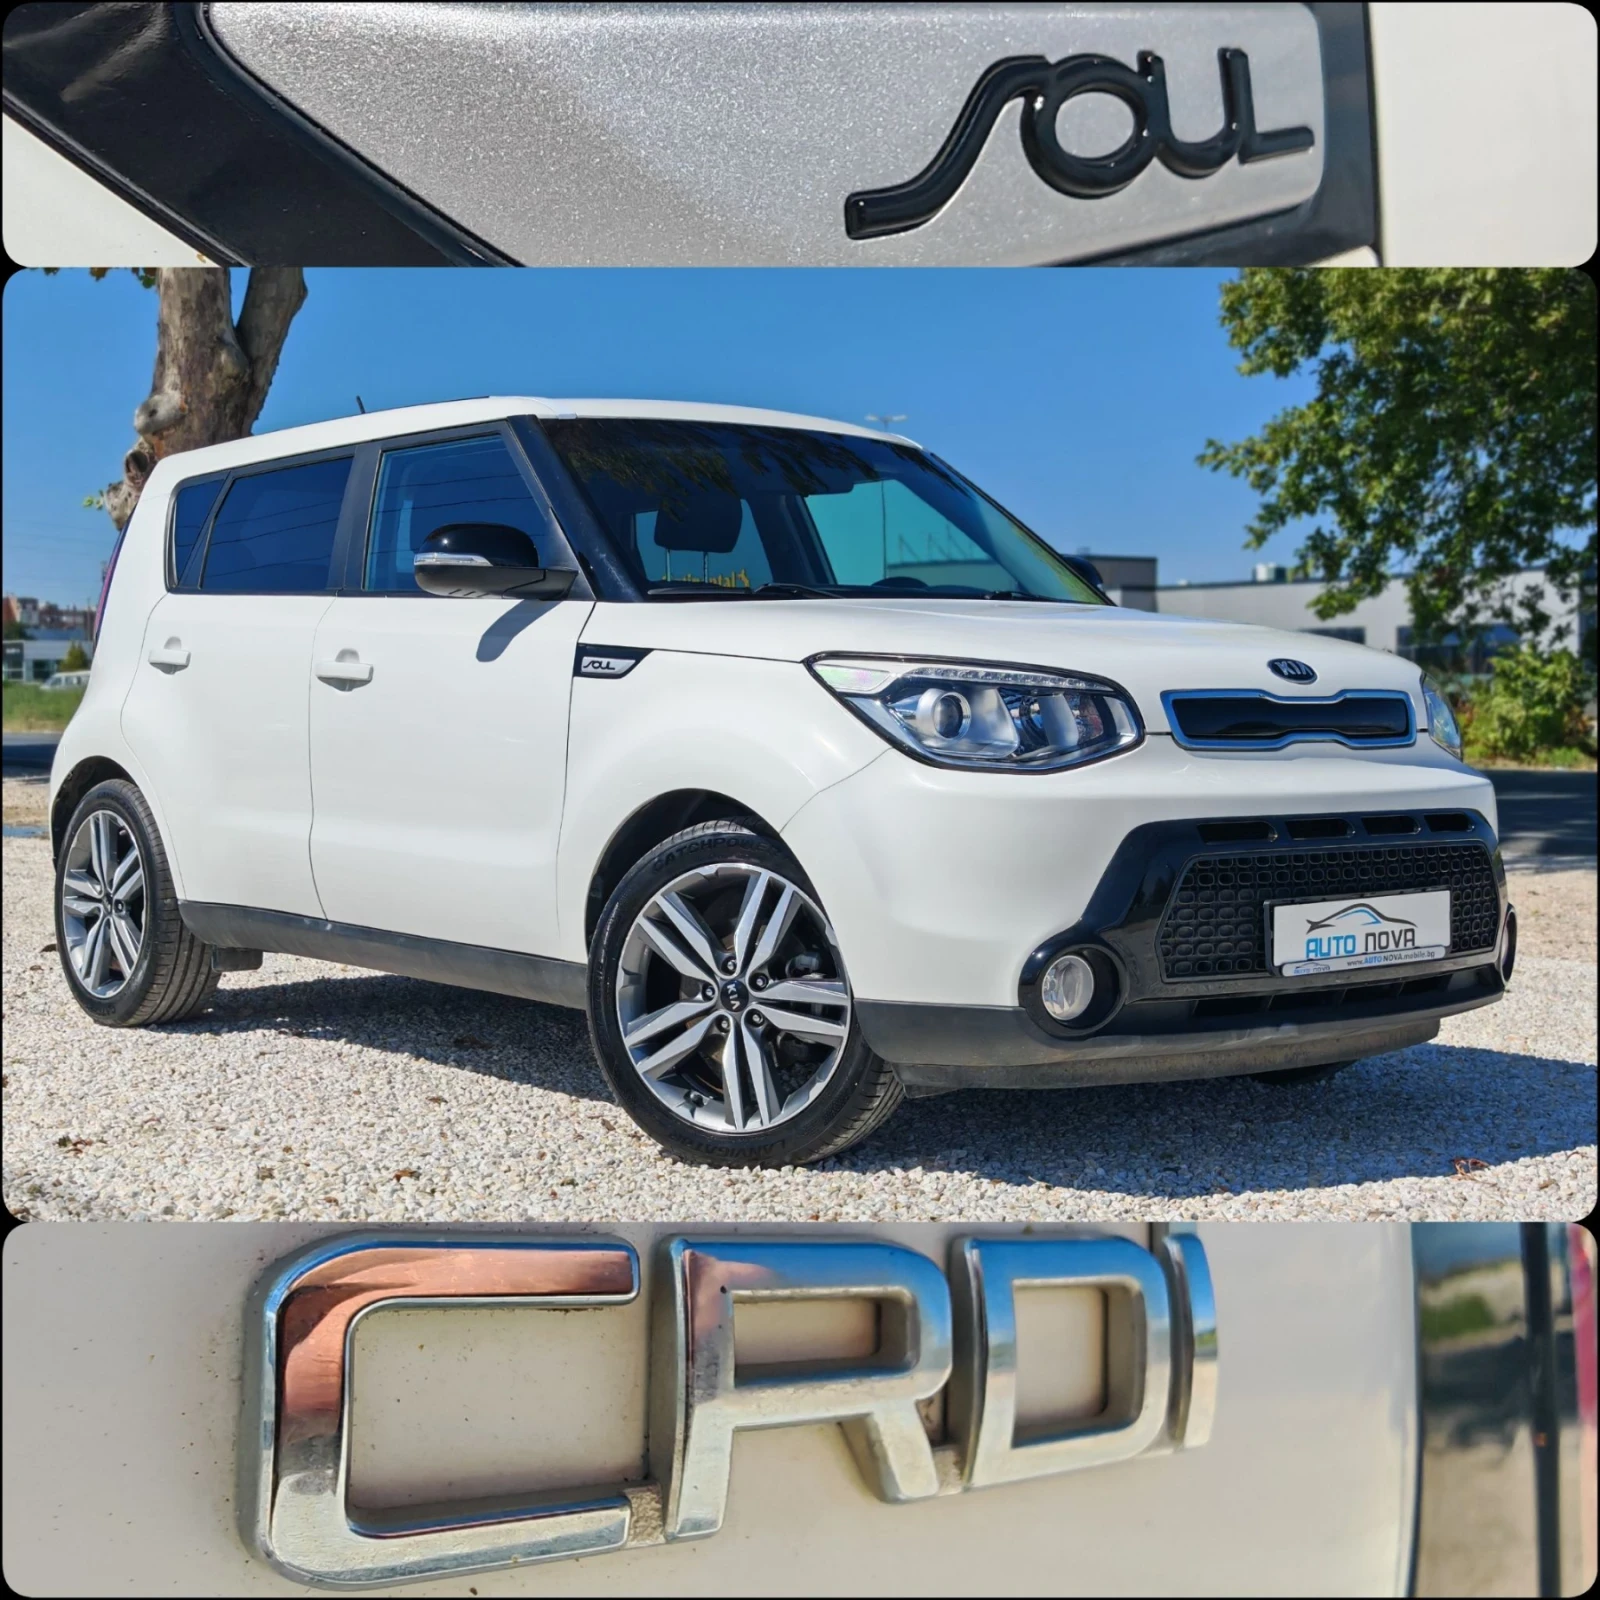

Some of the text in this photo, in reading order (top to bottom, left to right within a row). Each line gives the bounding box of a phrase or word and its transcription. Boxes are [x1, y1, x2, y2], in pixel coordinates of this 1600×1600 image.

[1274, 660, 1314, 676] KIA
[1306, 935, 1357, 959] AUTO
[726, 983, 741, 1010] KIA
